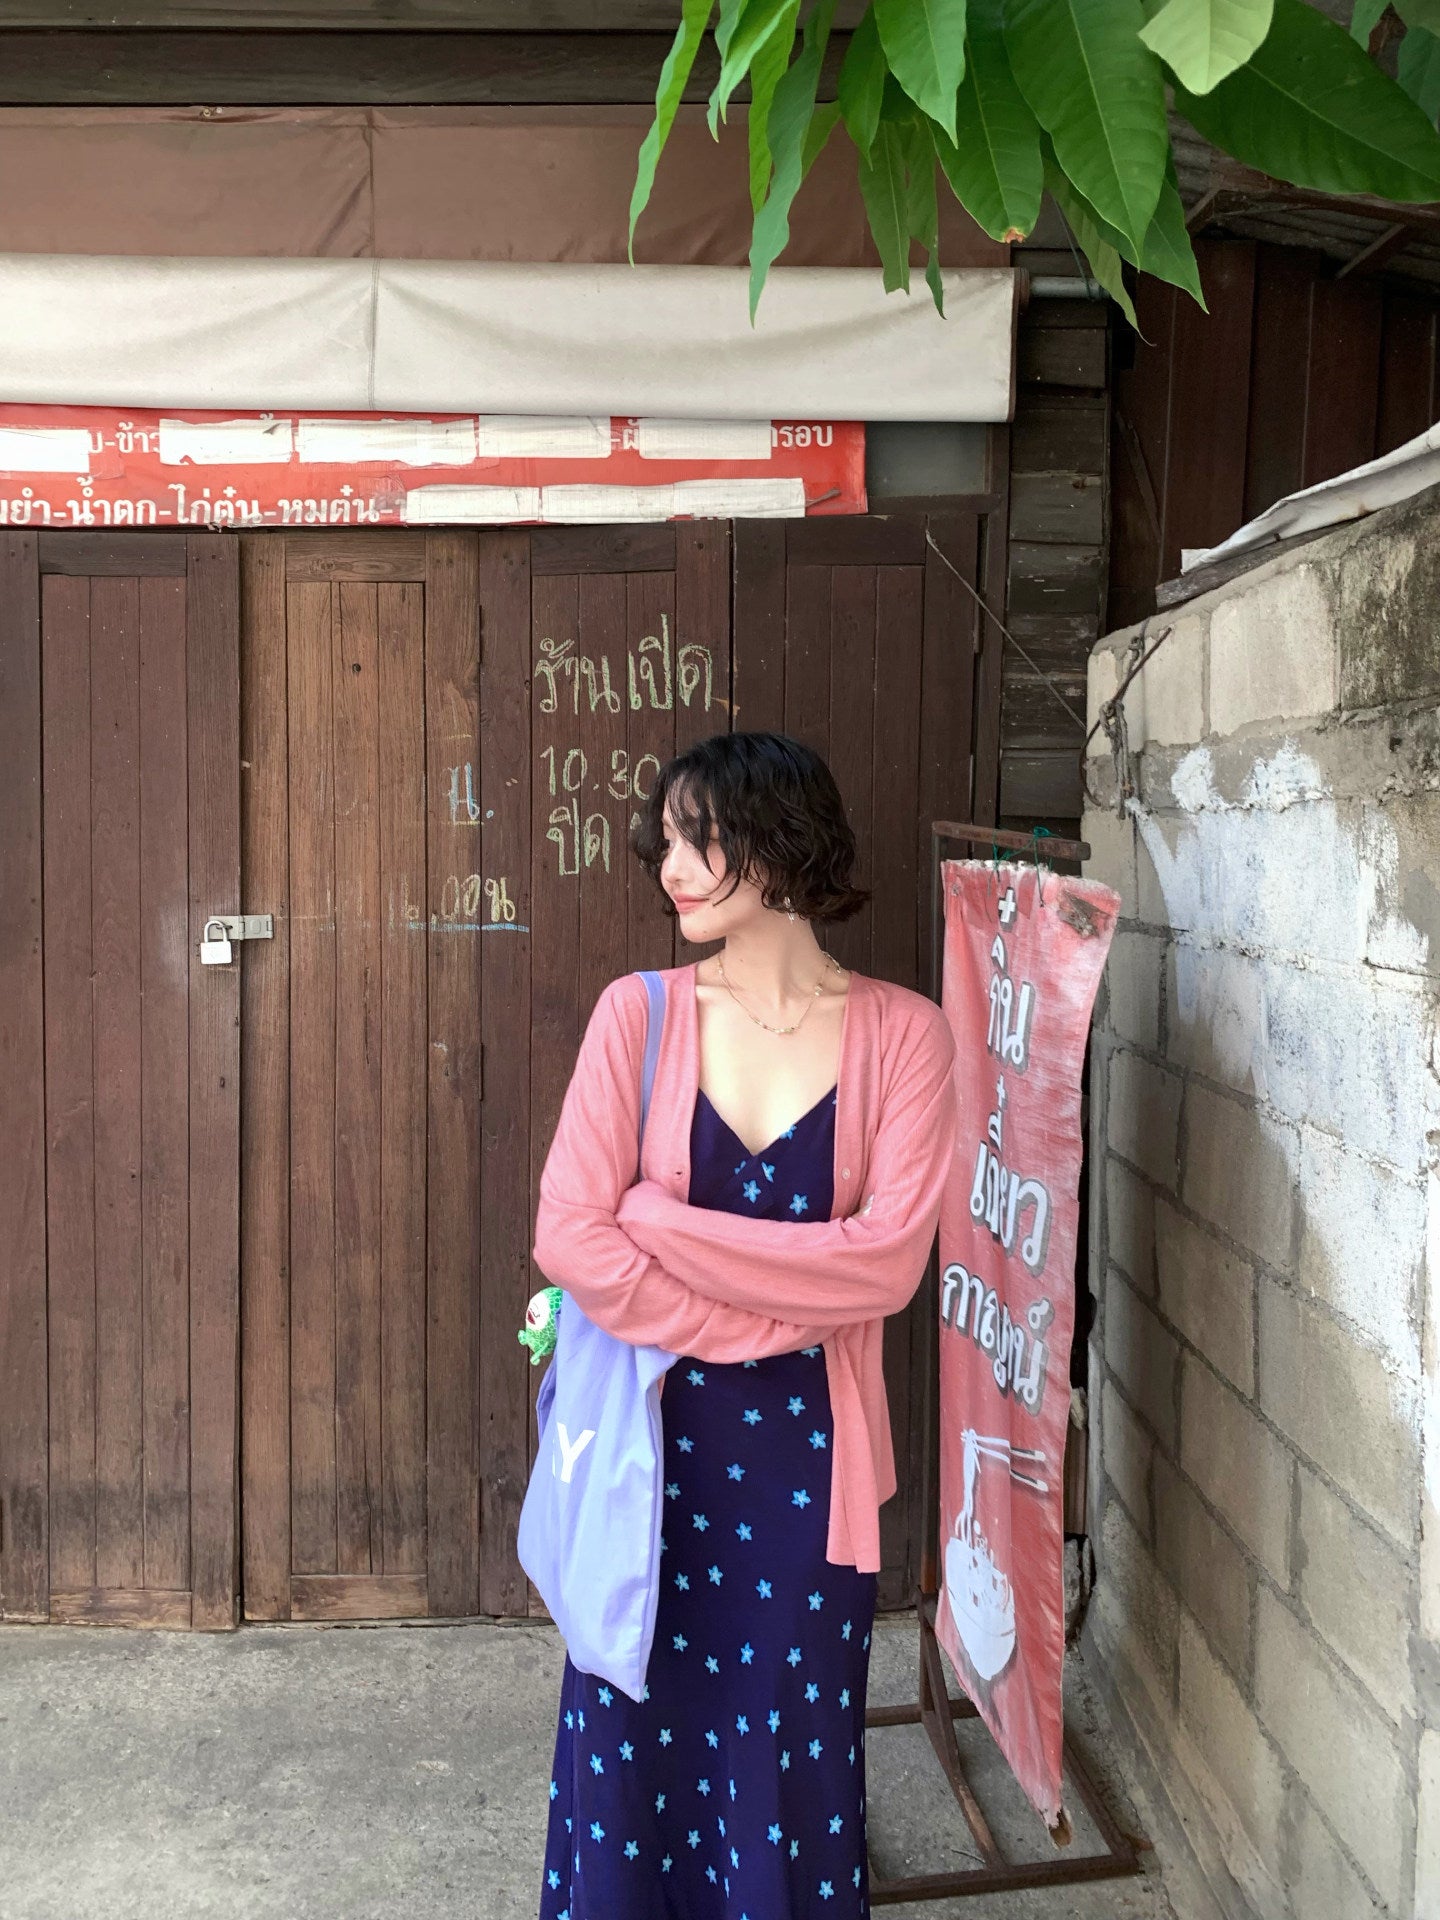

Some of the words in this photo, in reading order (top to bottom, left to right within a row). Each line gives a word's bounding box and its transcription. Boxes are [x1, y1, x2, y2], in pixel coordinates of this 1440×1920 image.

[540, 745, 661, 800] 10.30
[546, 798, 610, 876] ปิด
[552, 1421, 597, 1484] Y
